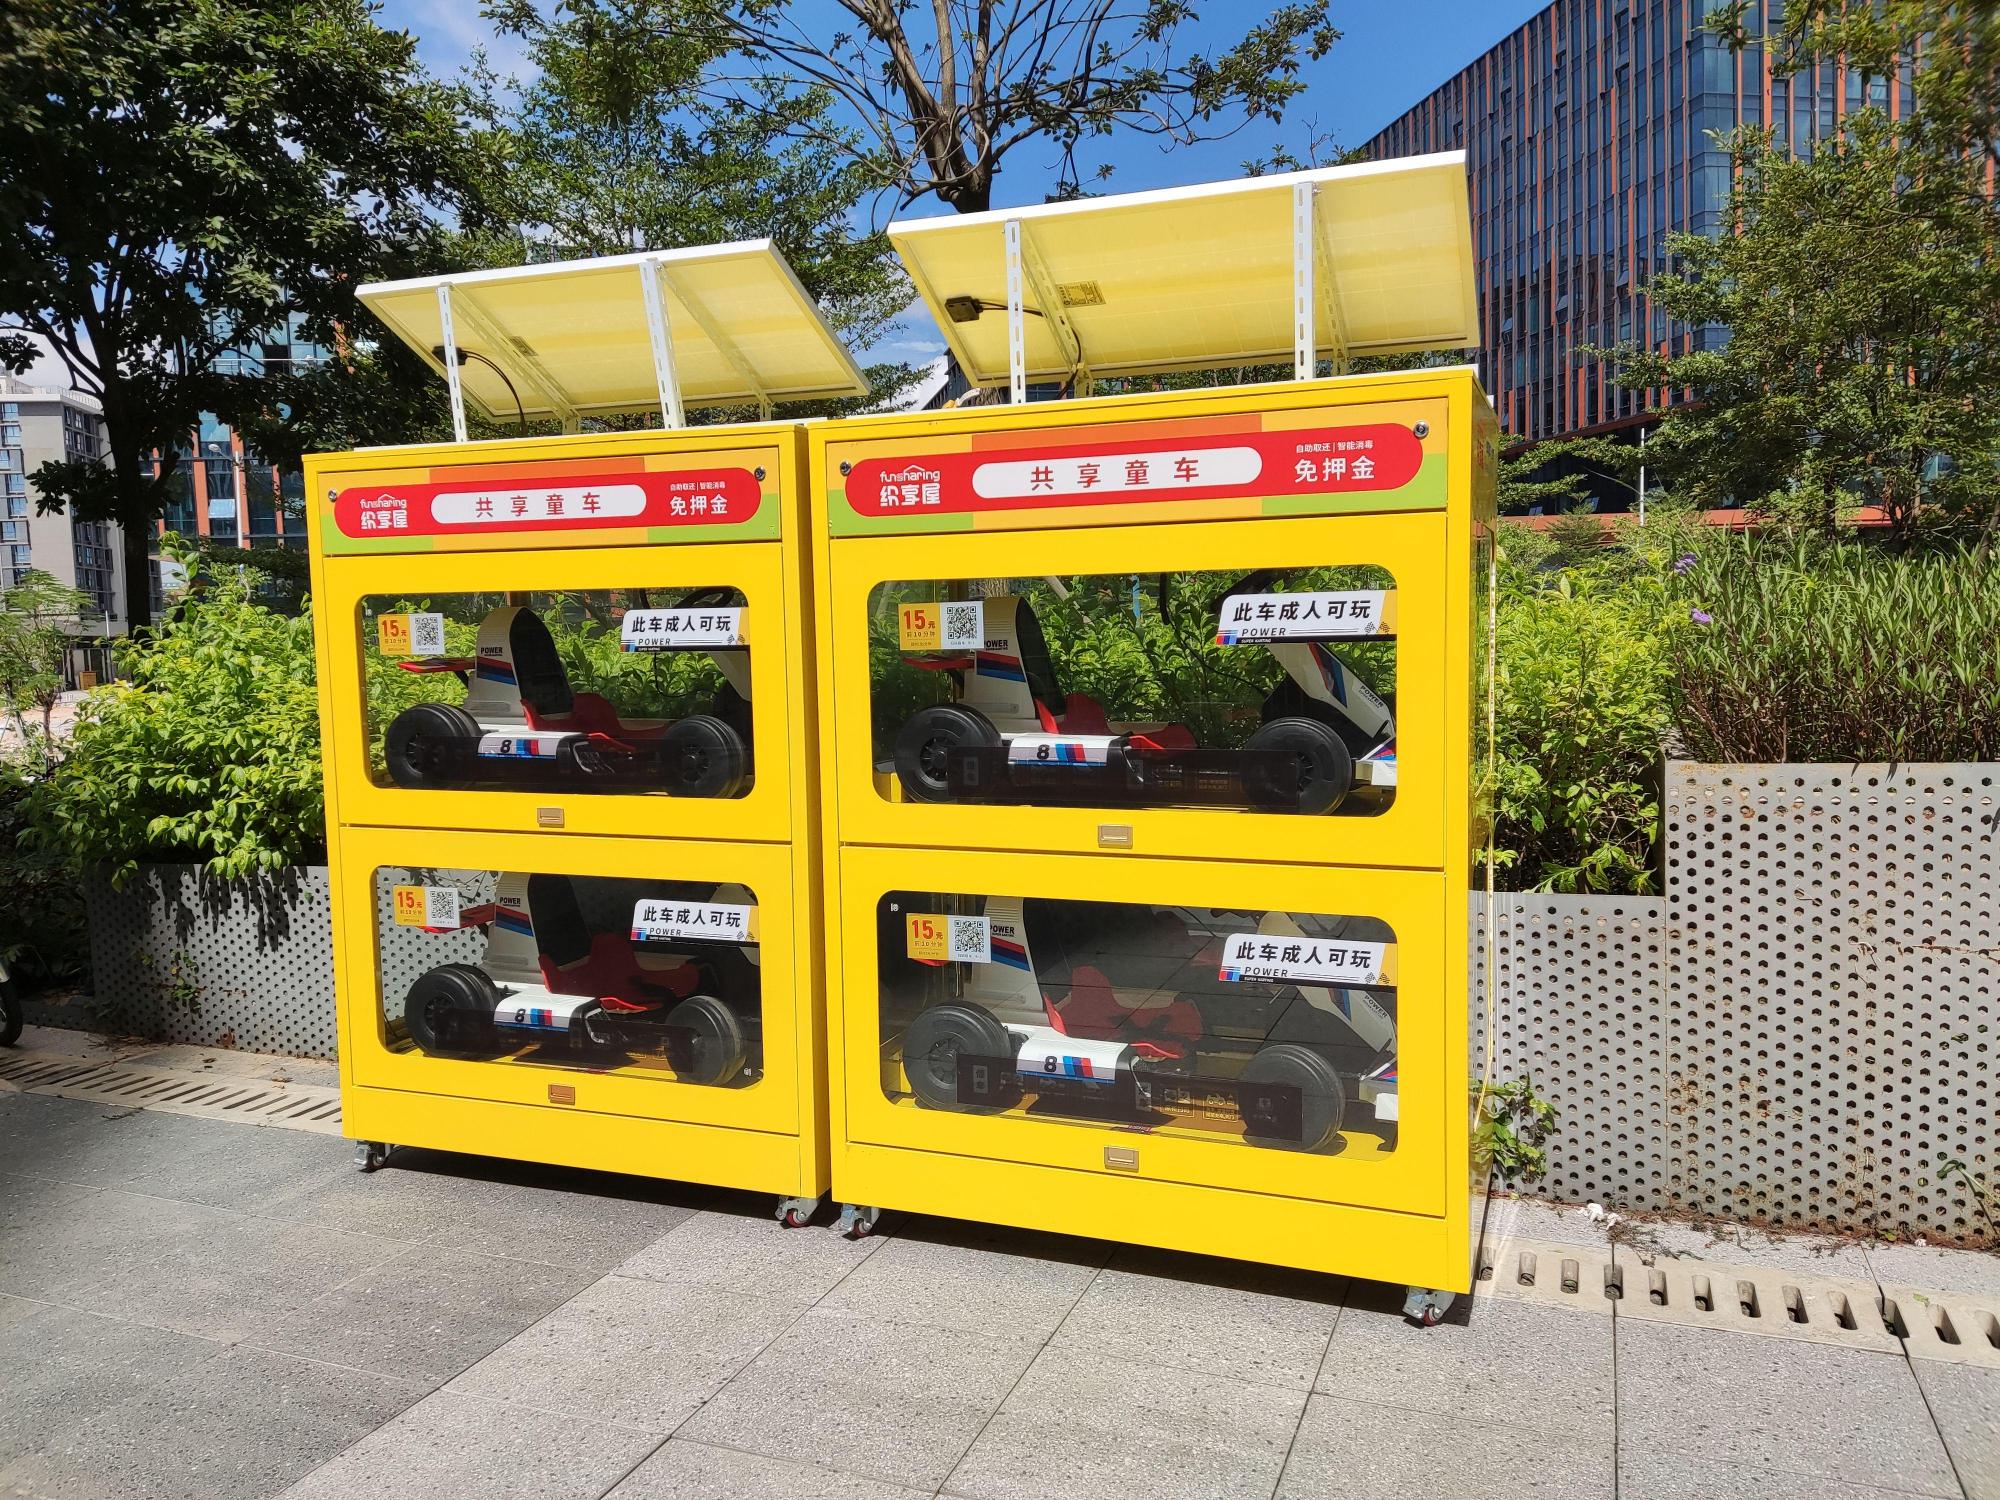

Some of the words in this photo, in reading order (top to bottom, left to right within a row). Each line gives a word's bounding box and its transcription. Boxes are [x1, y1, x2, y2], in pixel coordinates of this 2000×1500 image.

[880, 465, 940, 482] funsharing
[1030, 457, 1200, 490] 共享童车
[1294, 455, 1376, 483] 免押金
[475, 492, 601, 518] 共享童车
[669, 493, 728, 515] 免押金
[1233, 600, 1371, 622] 此车成人可玩
[632, 615, 731, 633] 此车成人可玩
[1241, 627, 1286, 637] POWER
[480, 646, 503, 655] POWER
[984, 639, 1009, 648] OWER
[500, 739, 513, 754] 8
[1036, 744, 1050, 760] 8
[500, 897, 521, 905] POWER
[642, 906, 741, 928] 此车成人可玩
[649, 928, 682, 937] POWER
[1236, 942, 1371, 969] 此车成人可玩
[1244, 966, 1288, 978] POWER
[514, 1009, 525, 1023] 8
[1044, 1055, 1058, 1073] 8
